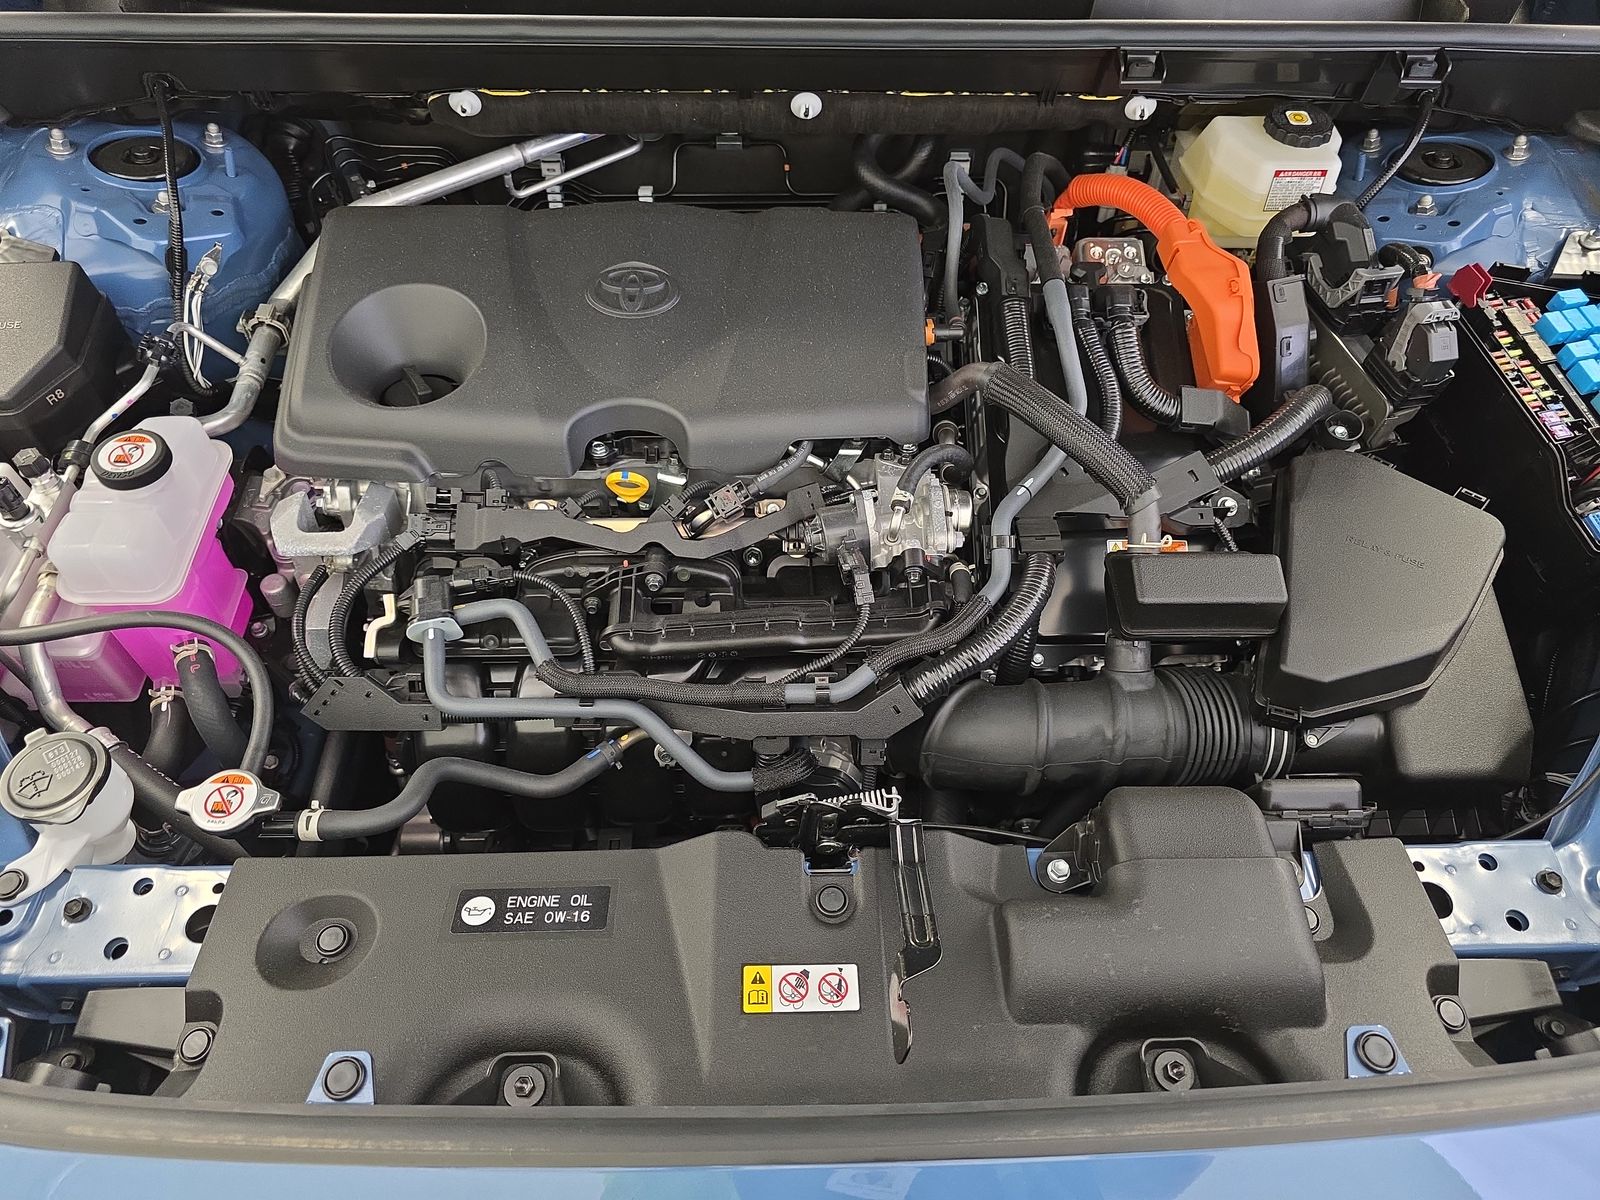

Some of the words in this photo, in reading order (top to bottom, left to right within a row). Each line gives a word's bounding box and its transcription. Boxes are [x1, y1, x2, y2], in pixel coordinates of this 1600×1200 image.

[46, 389, 65, 406] R8
[100, 469, 135, 479] DENSO
[506, 895, 561, 908] ENGINE
[570, 894, 593, 907] OIL
[503, 912, 535, 924] SAE
[544, 910, 591, 924] 0W-16
